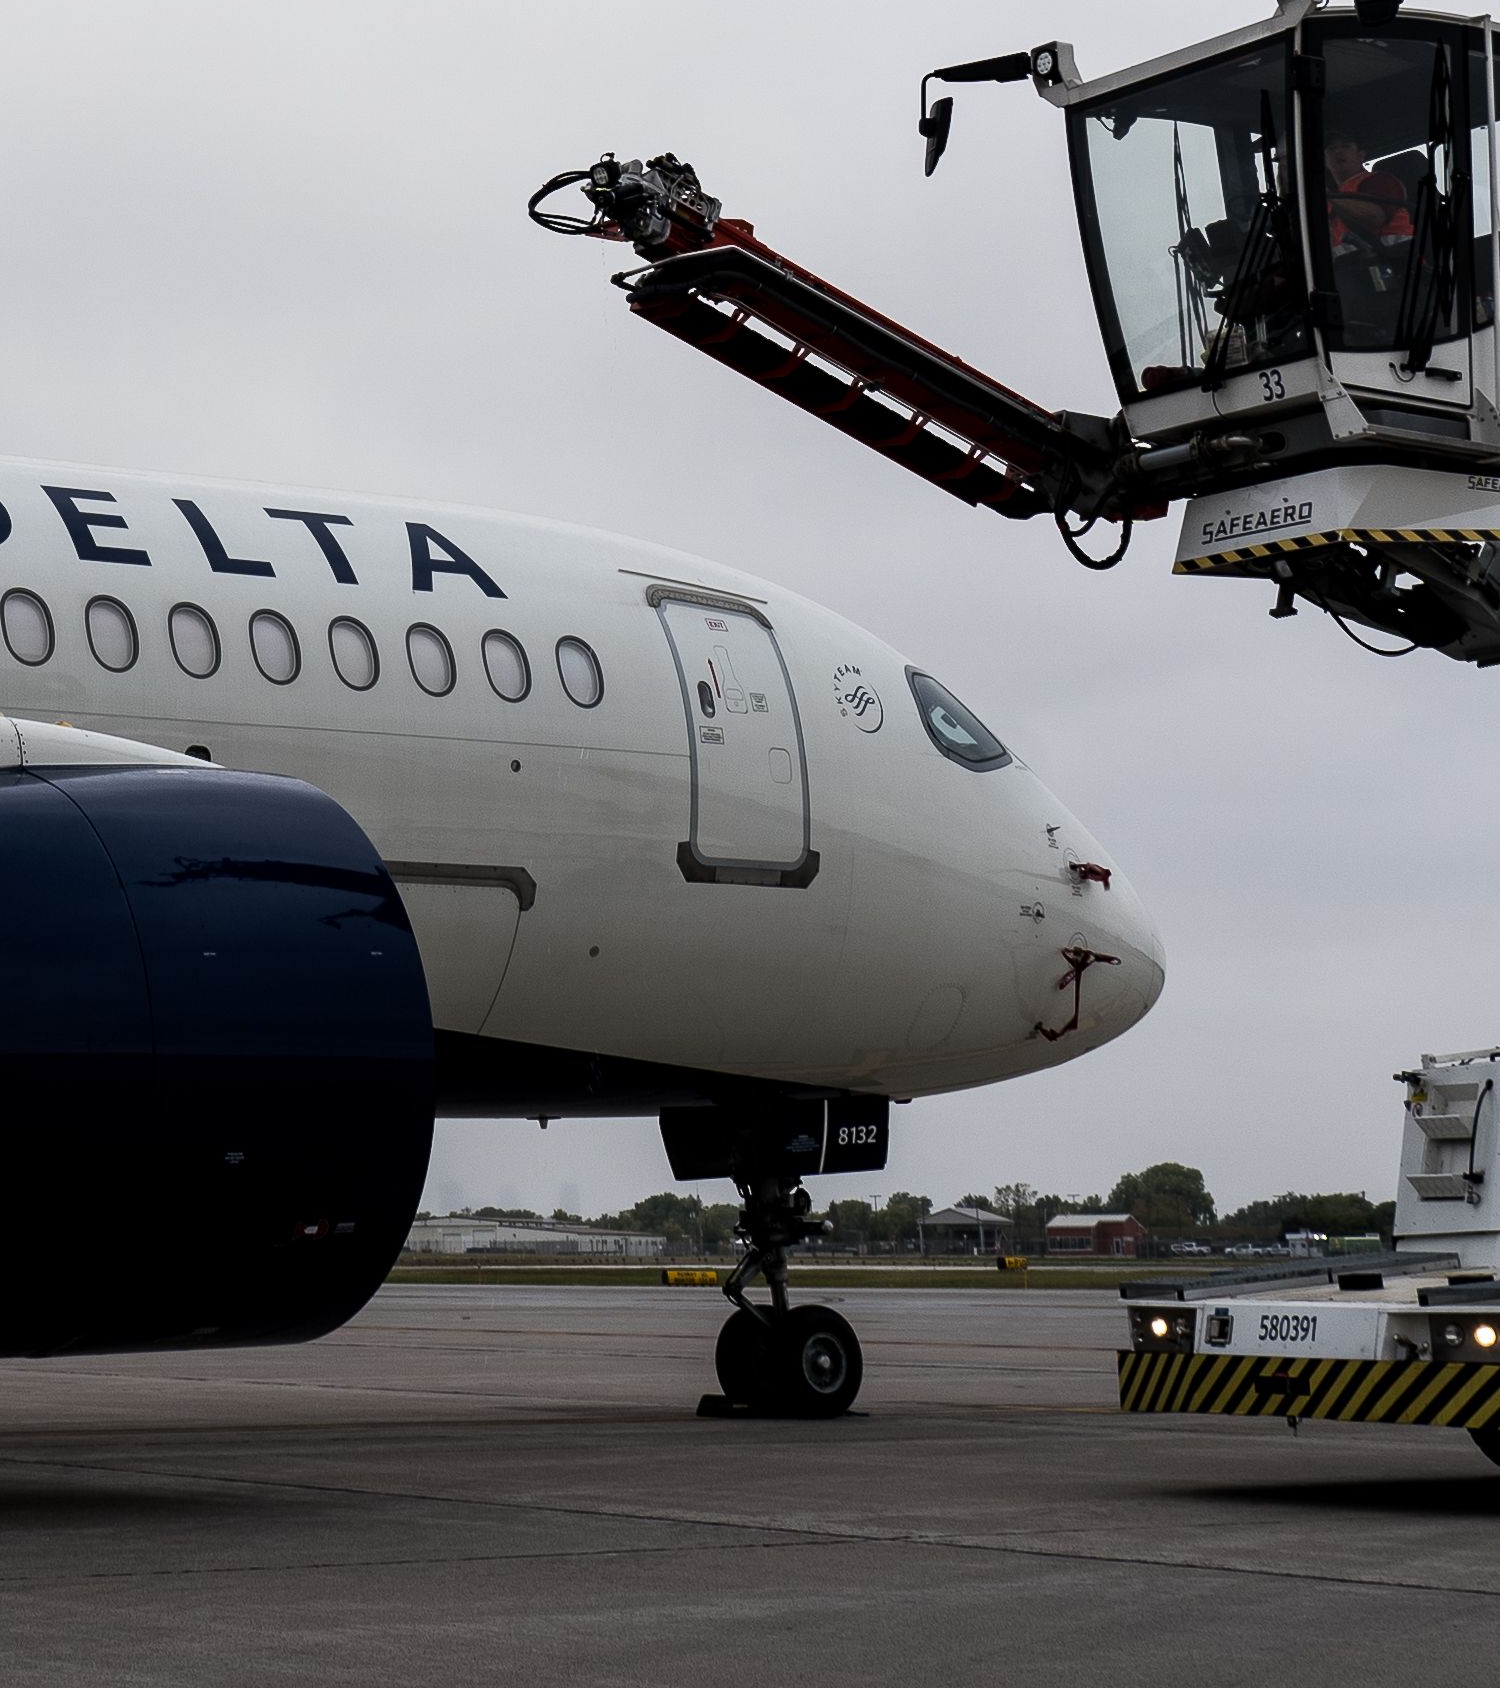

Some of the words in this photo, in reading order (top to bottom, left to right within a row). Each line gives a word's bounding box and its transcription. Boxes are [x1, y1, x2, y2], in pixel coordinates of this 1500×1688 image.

[1259, 369, 1285, 402] 33
[1202, 502, 1312, 545] SAFEAERO
[838, 1125, 877, 1145] 8132
[1258, 1314, 1317, 1342] 580391
